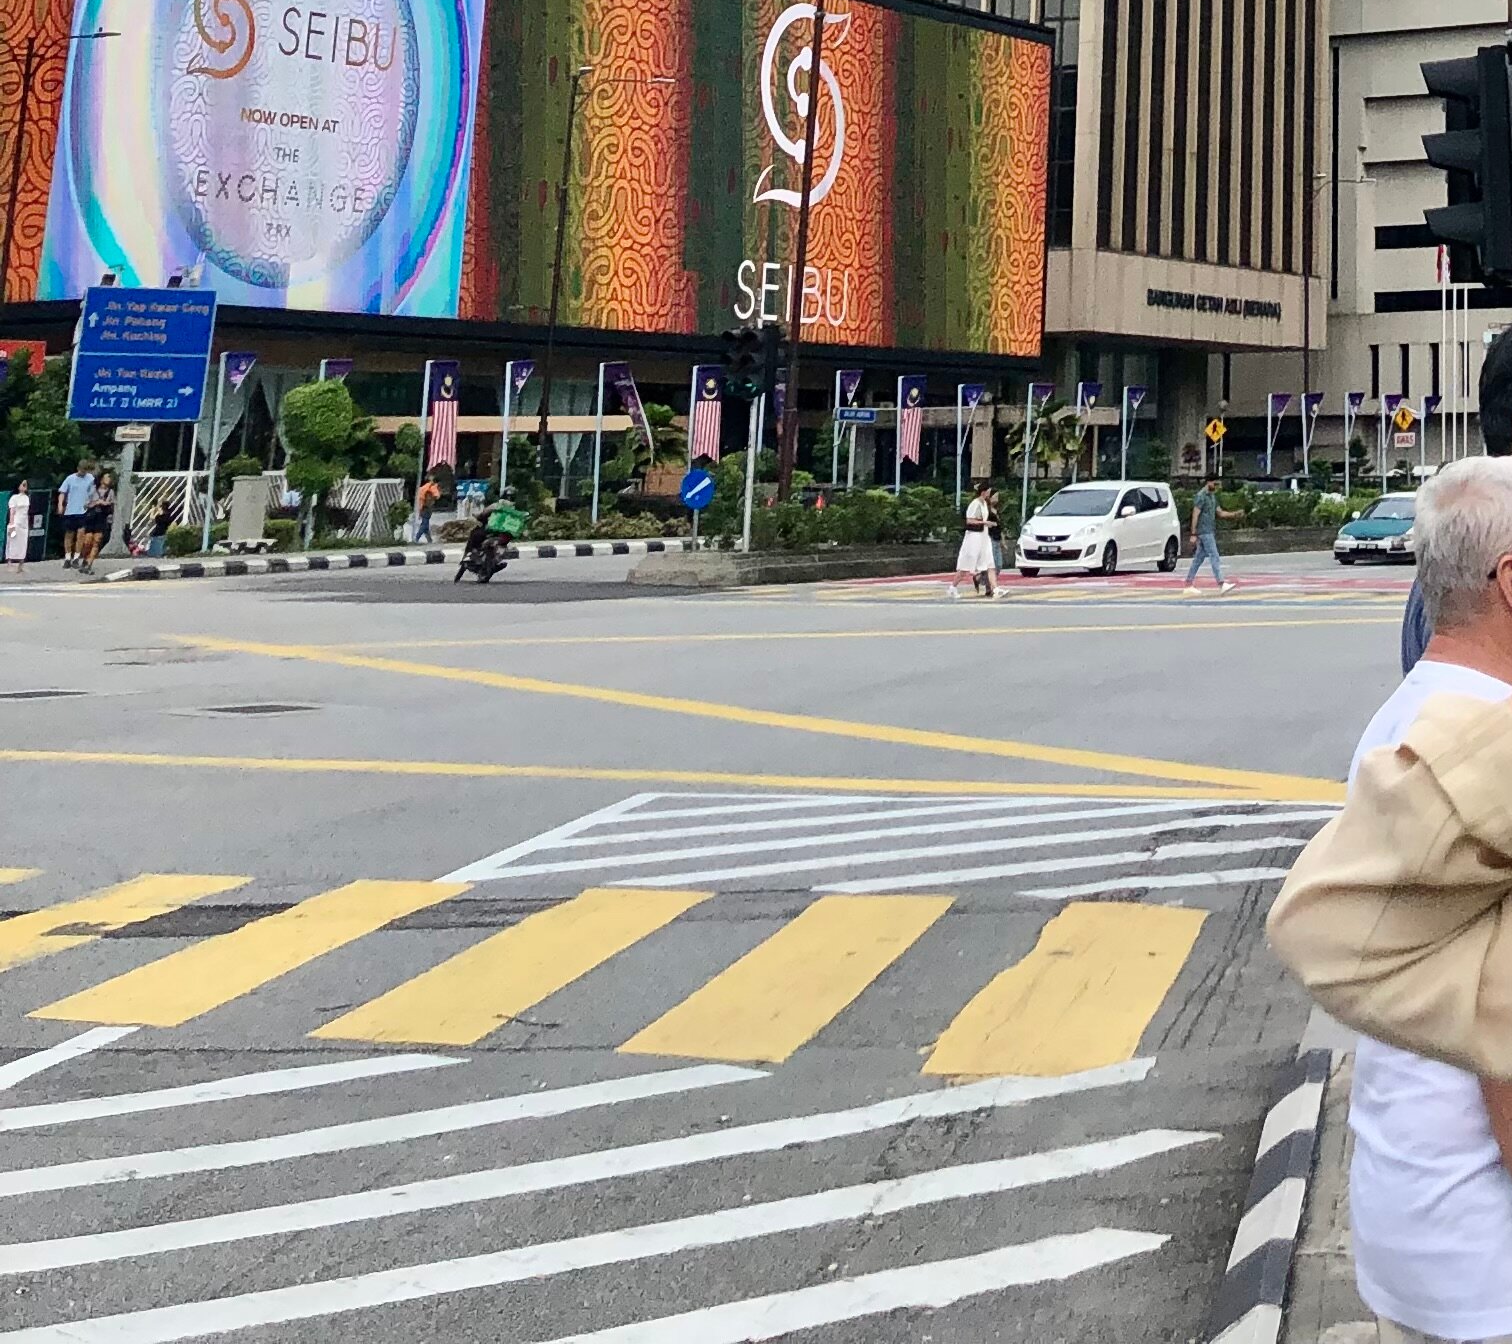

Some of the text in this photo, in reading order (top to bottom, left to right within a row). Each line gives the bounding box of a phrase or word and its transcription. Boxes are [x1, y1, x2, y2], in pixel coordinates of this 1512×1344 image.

[278, 7, 397, 71] SEIBU
[240, 108, 339, 133] NOW OPEN AT
[274, 146, 300, 163] THE
[195, 169, 365, 214] EXCHANGE
[734, 259, 849, 327] SEIBU
[91, 382, 138, 395] Ampang
